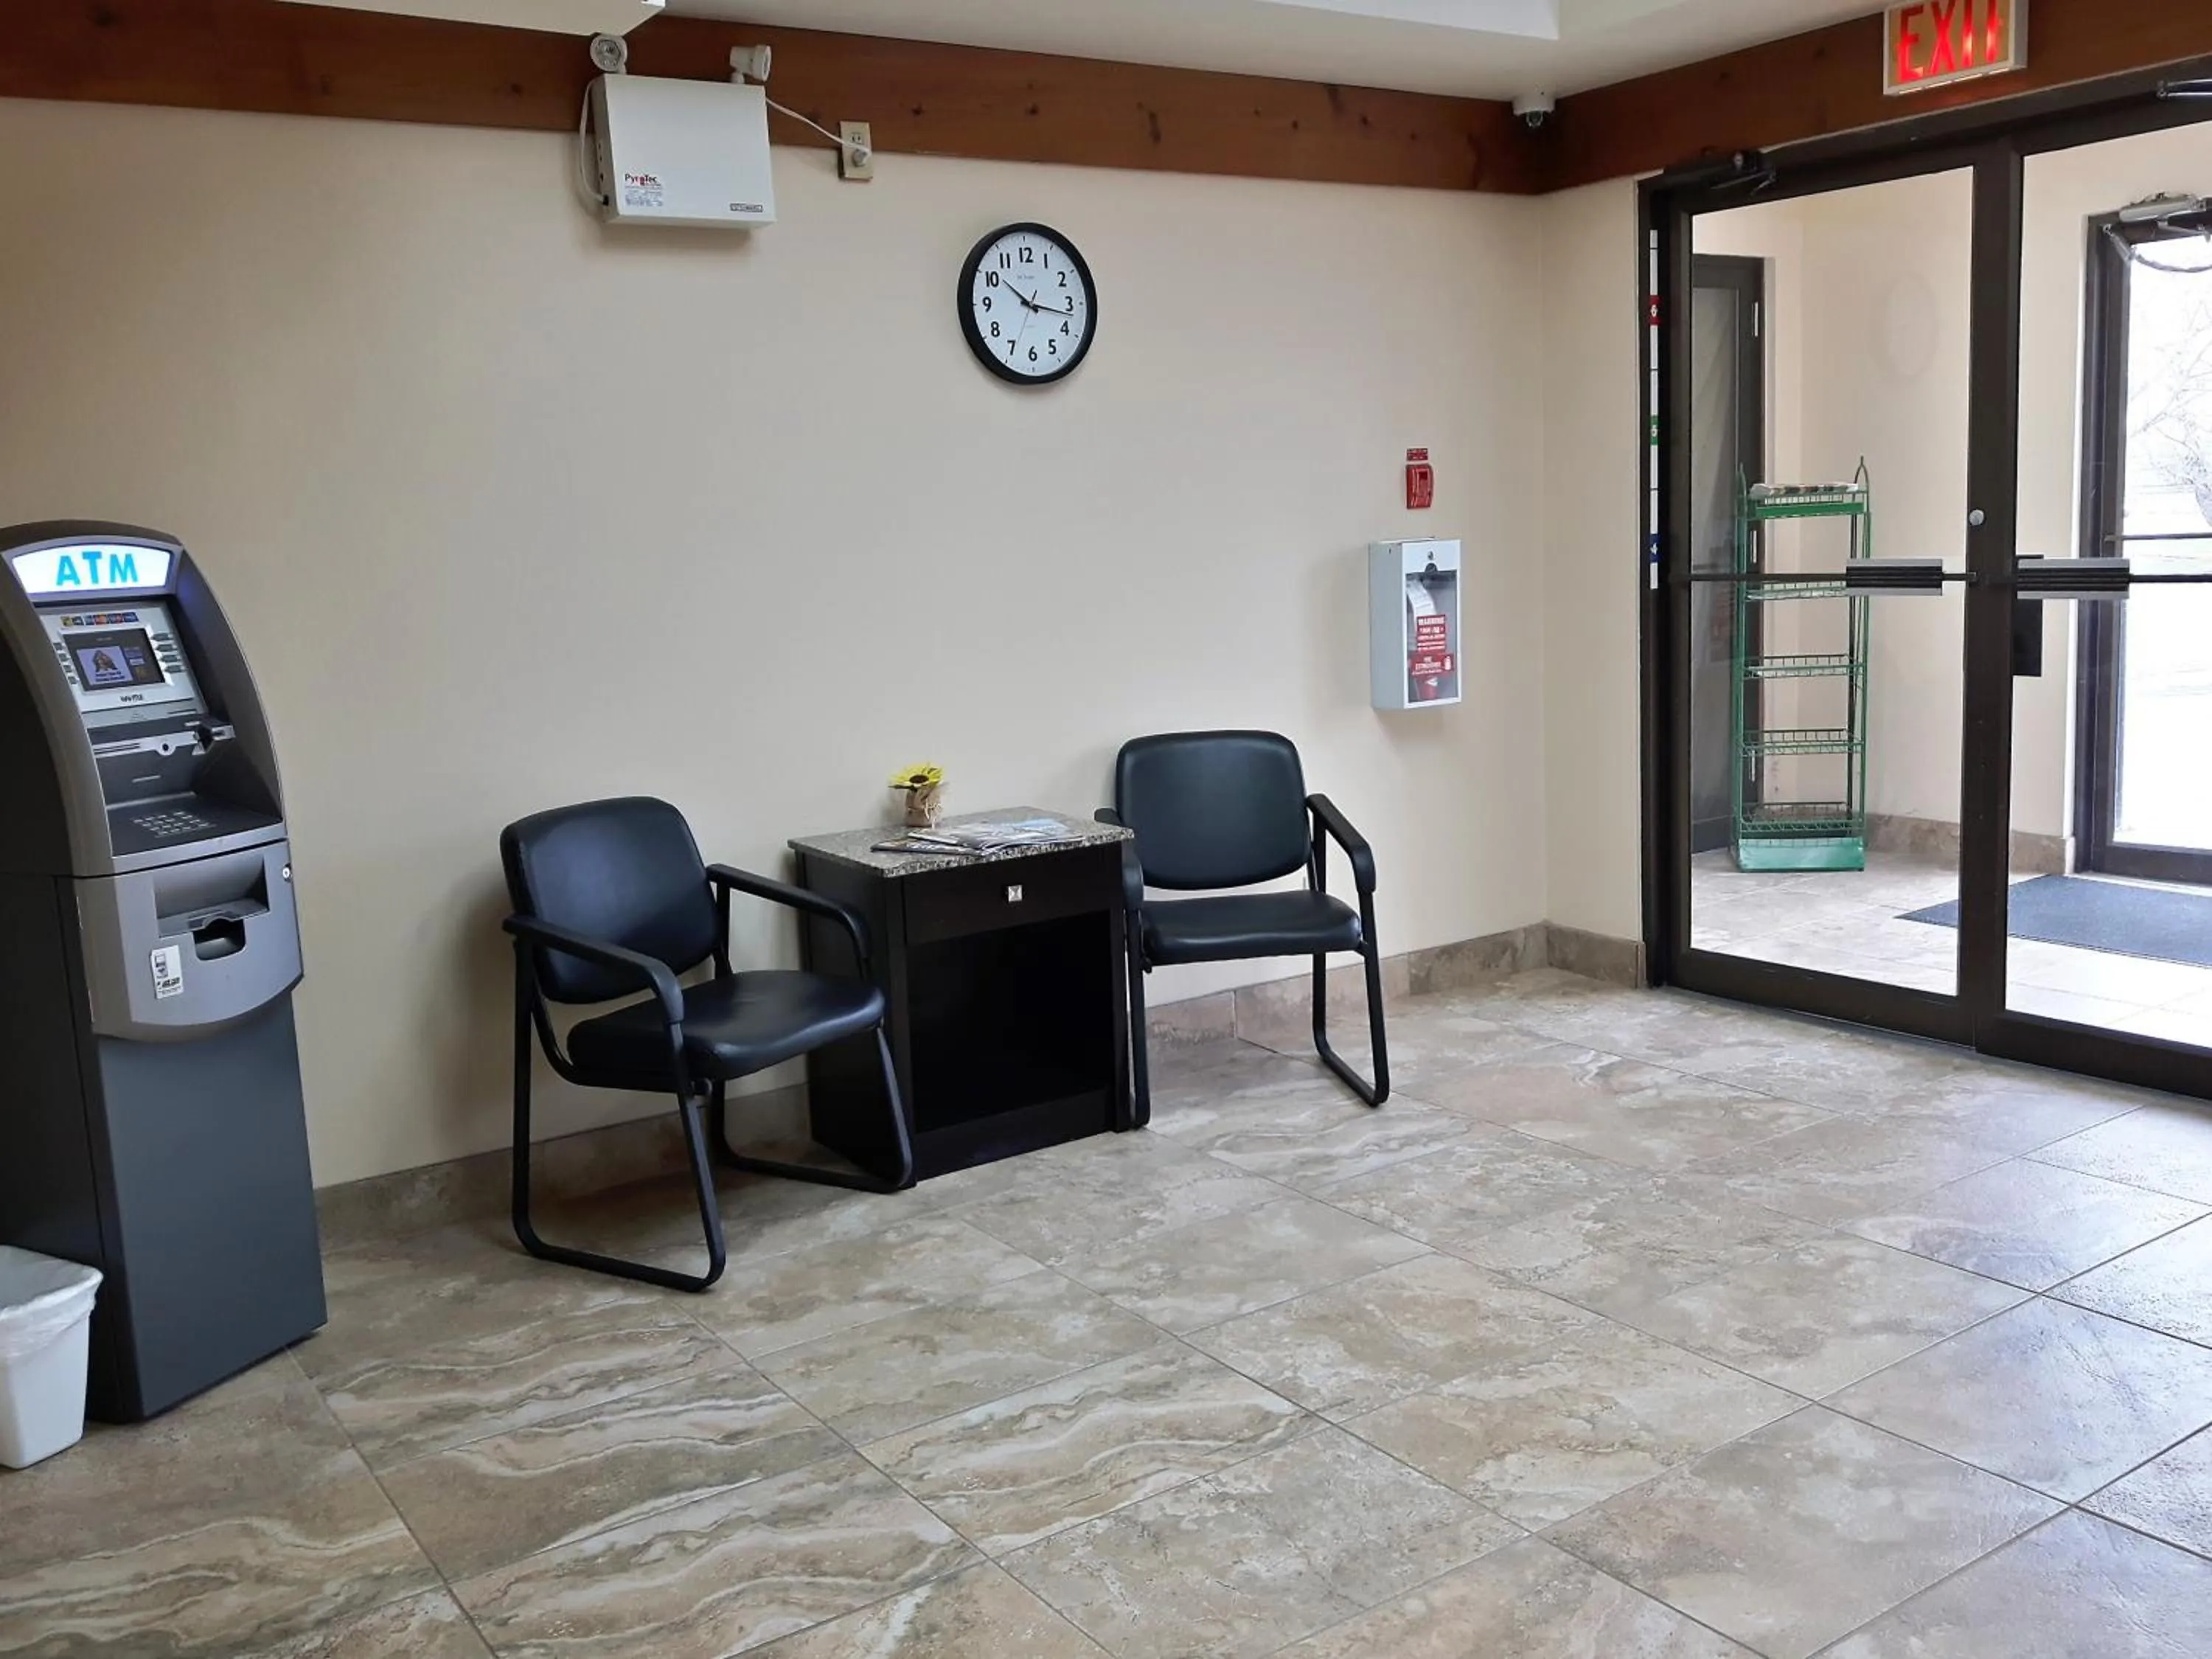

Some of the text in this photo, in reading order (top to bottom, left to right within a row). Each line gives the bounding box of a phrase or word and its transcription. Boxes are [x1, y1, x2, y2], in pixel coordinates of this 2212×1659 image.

[999, 253, 1011, 269] 11
[1018, 247, 1034, 263] 12
[1043, 253, 1048, 269] 1
[985, 271, 999, 287] 10
[1057, 271, 1067, 287] 2
[982, 297, 992, 313] 9
[1065, 296, 1074, 312] 3
[990, 321, 1001, 337] 8
[1060, 320, 1070, 335] 4
[1007, 340, 1016, 355] 7
[1028, 346, 1037, 361] 6
[1048, 339, 1057, 355] 5
[56, 551, 138, 585] ATM
